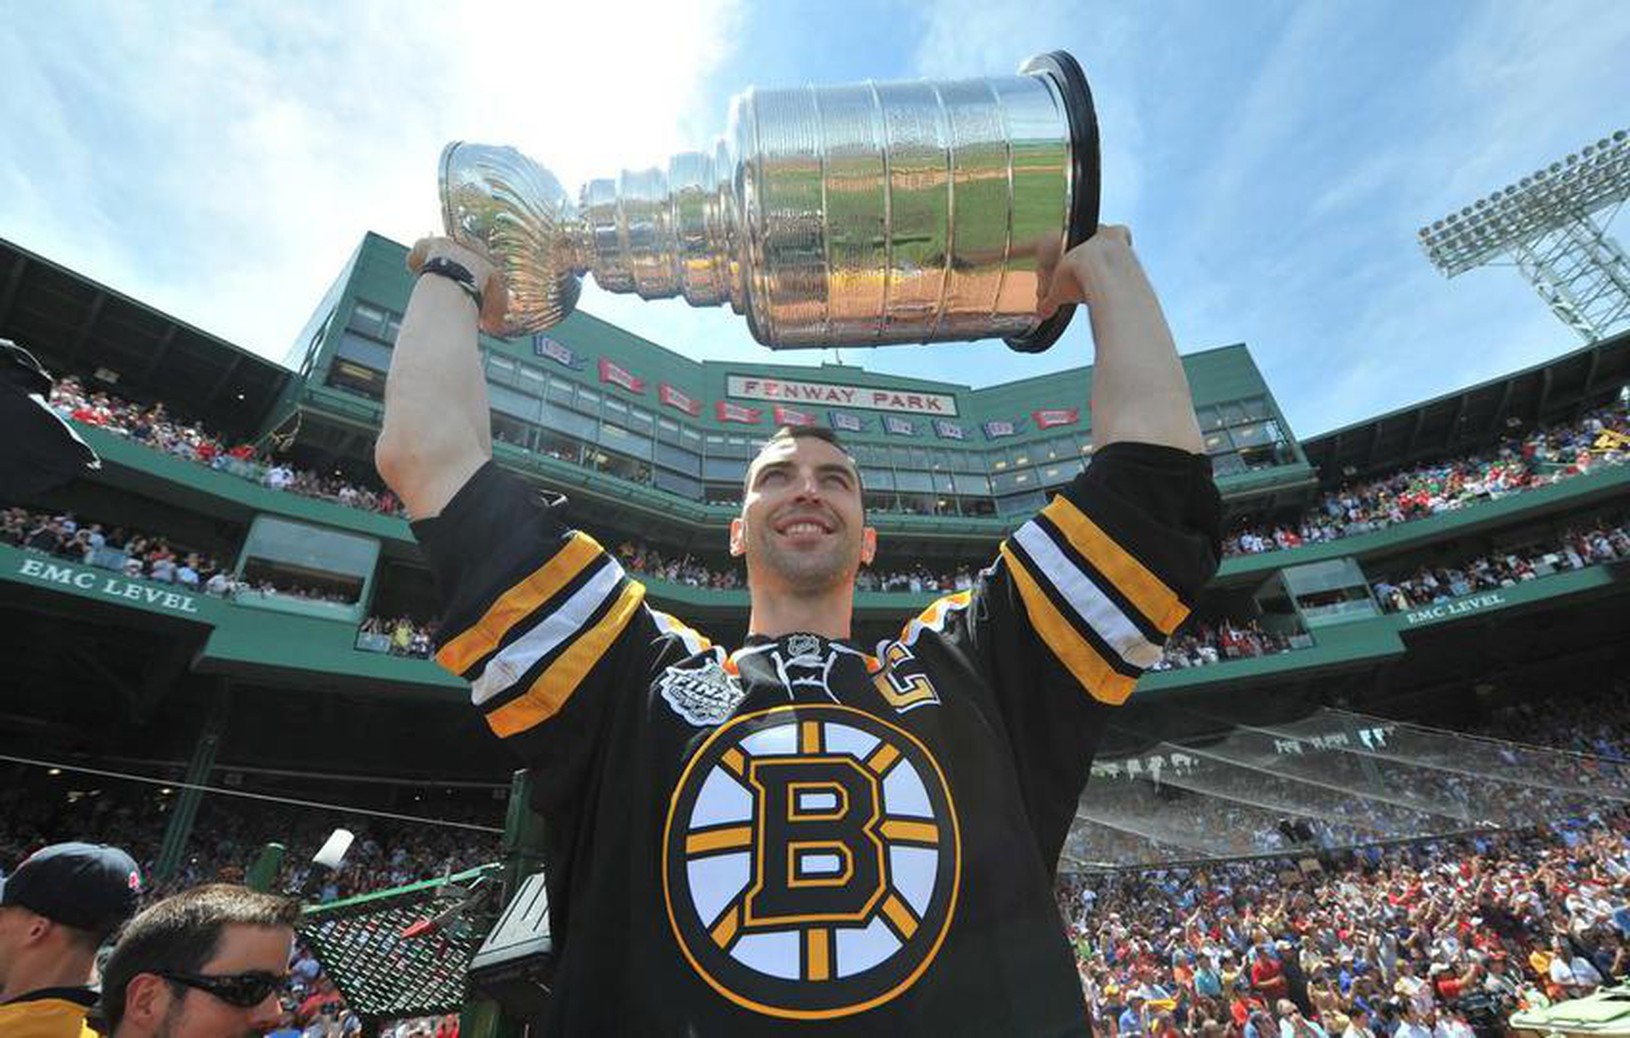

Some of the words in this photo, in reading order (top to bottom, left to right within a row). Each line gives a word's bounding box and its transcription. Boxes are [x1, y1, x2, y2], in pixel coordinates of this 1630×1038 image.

[743, 380, 856, 403] FENWAY
[871, 392, 942, 412] PARK
[19, 558, 96, 589] EMC
[103, 578, 198, 613] LEVEL
[1406, 604, 1446, 624] EMC
[1448, 594, 1506, 614] LEVEL
[744, 757, 886, 927] B
